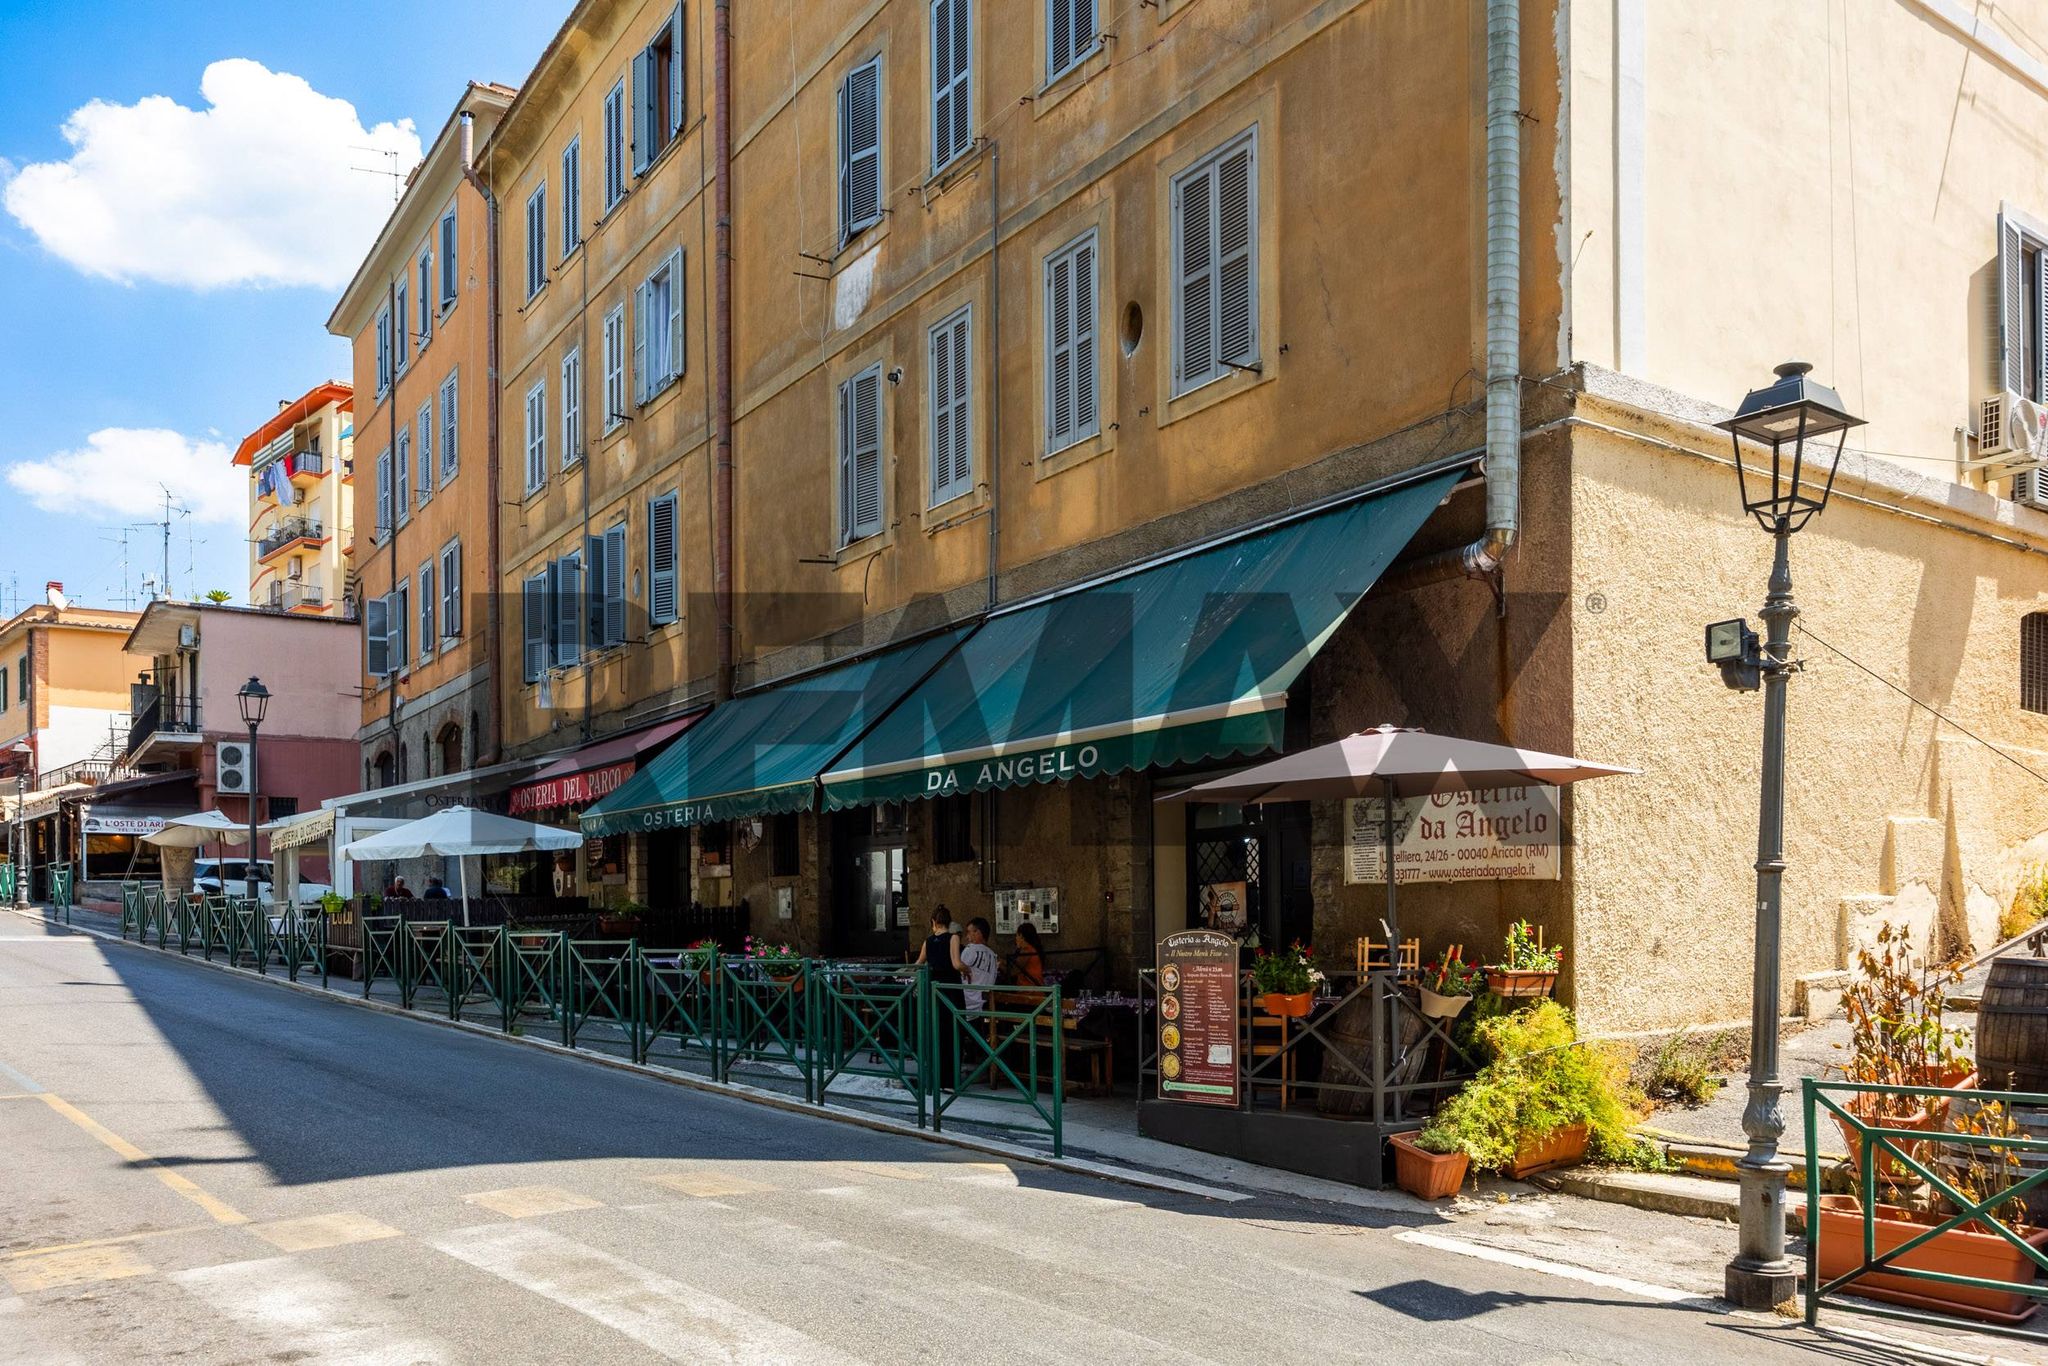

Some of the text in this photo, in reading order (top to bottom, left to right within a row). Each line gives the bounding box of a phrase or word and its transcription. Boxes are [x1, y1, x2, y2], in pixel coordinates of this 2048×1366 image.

[926, 744, 1100, 791] DA ANGELO
[520, 783, 558, 809] OSTERIA
[563, 777, 582, 801] DEL
[588, 767, 622, 796] PARCO
[642, 804, 715, 827] OSTERIA
[1420, 807, 1548, 841] da Angelo
[1425, 849, 1449, 862] 24/26
[1457, 847, 1488, 860] 00040
[1491, 845, 1523, 859] Ariccia
[1525, 843, 1550, 860] (RM)
[1428, 863, 1537, 881] www.osteriadaangelo.it
